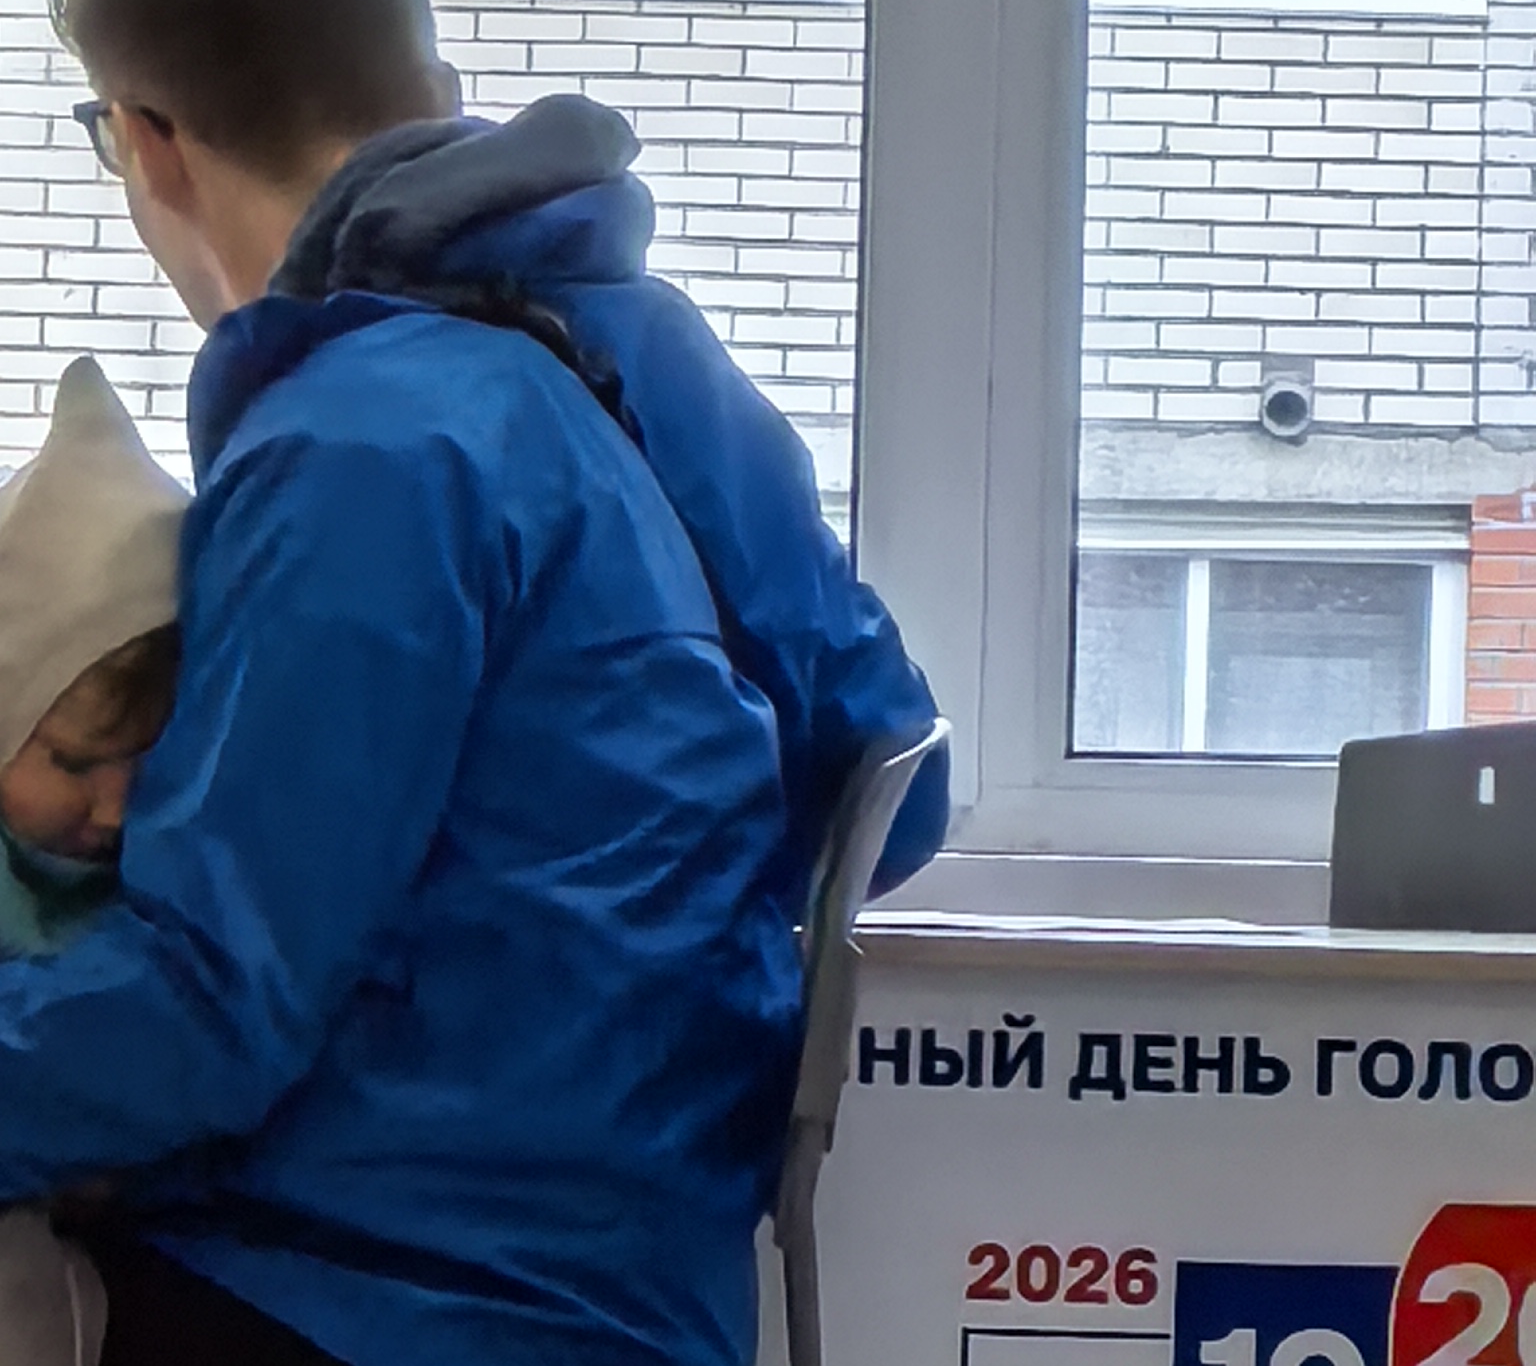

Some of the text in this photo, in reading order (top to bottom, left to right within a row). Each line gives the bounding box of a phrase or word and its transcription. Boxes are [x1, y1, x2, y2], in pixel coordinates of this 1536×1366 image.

[858, 1013, 1045, 1089] НЫЙ
[1068, 1032, 1291, 1101] ДЕНЬ
[966, 1243, 1158, 1305] 2026
